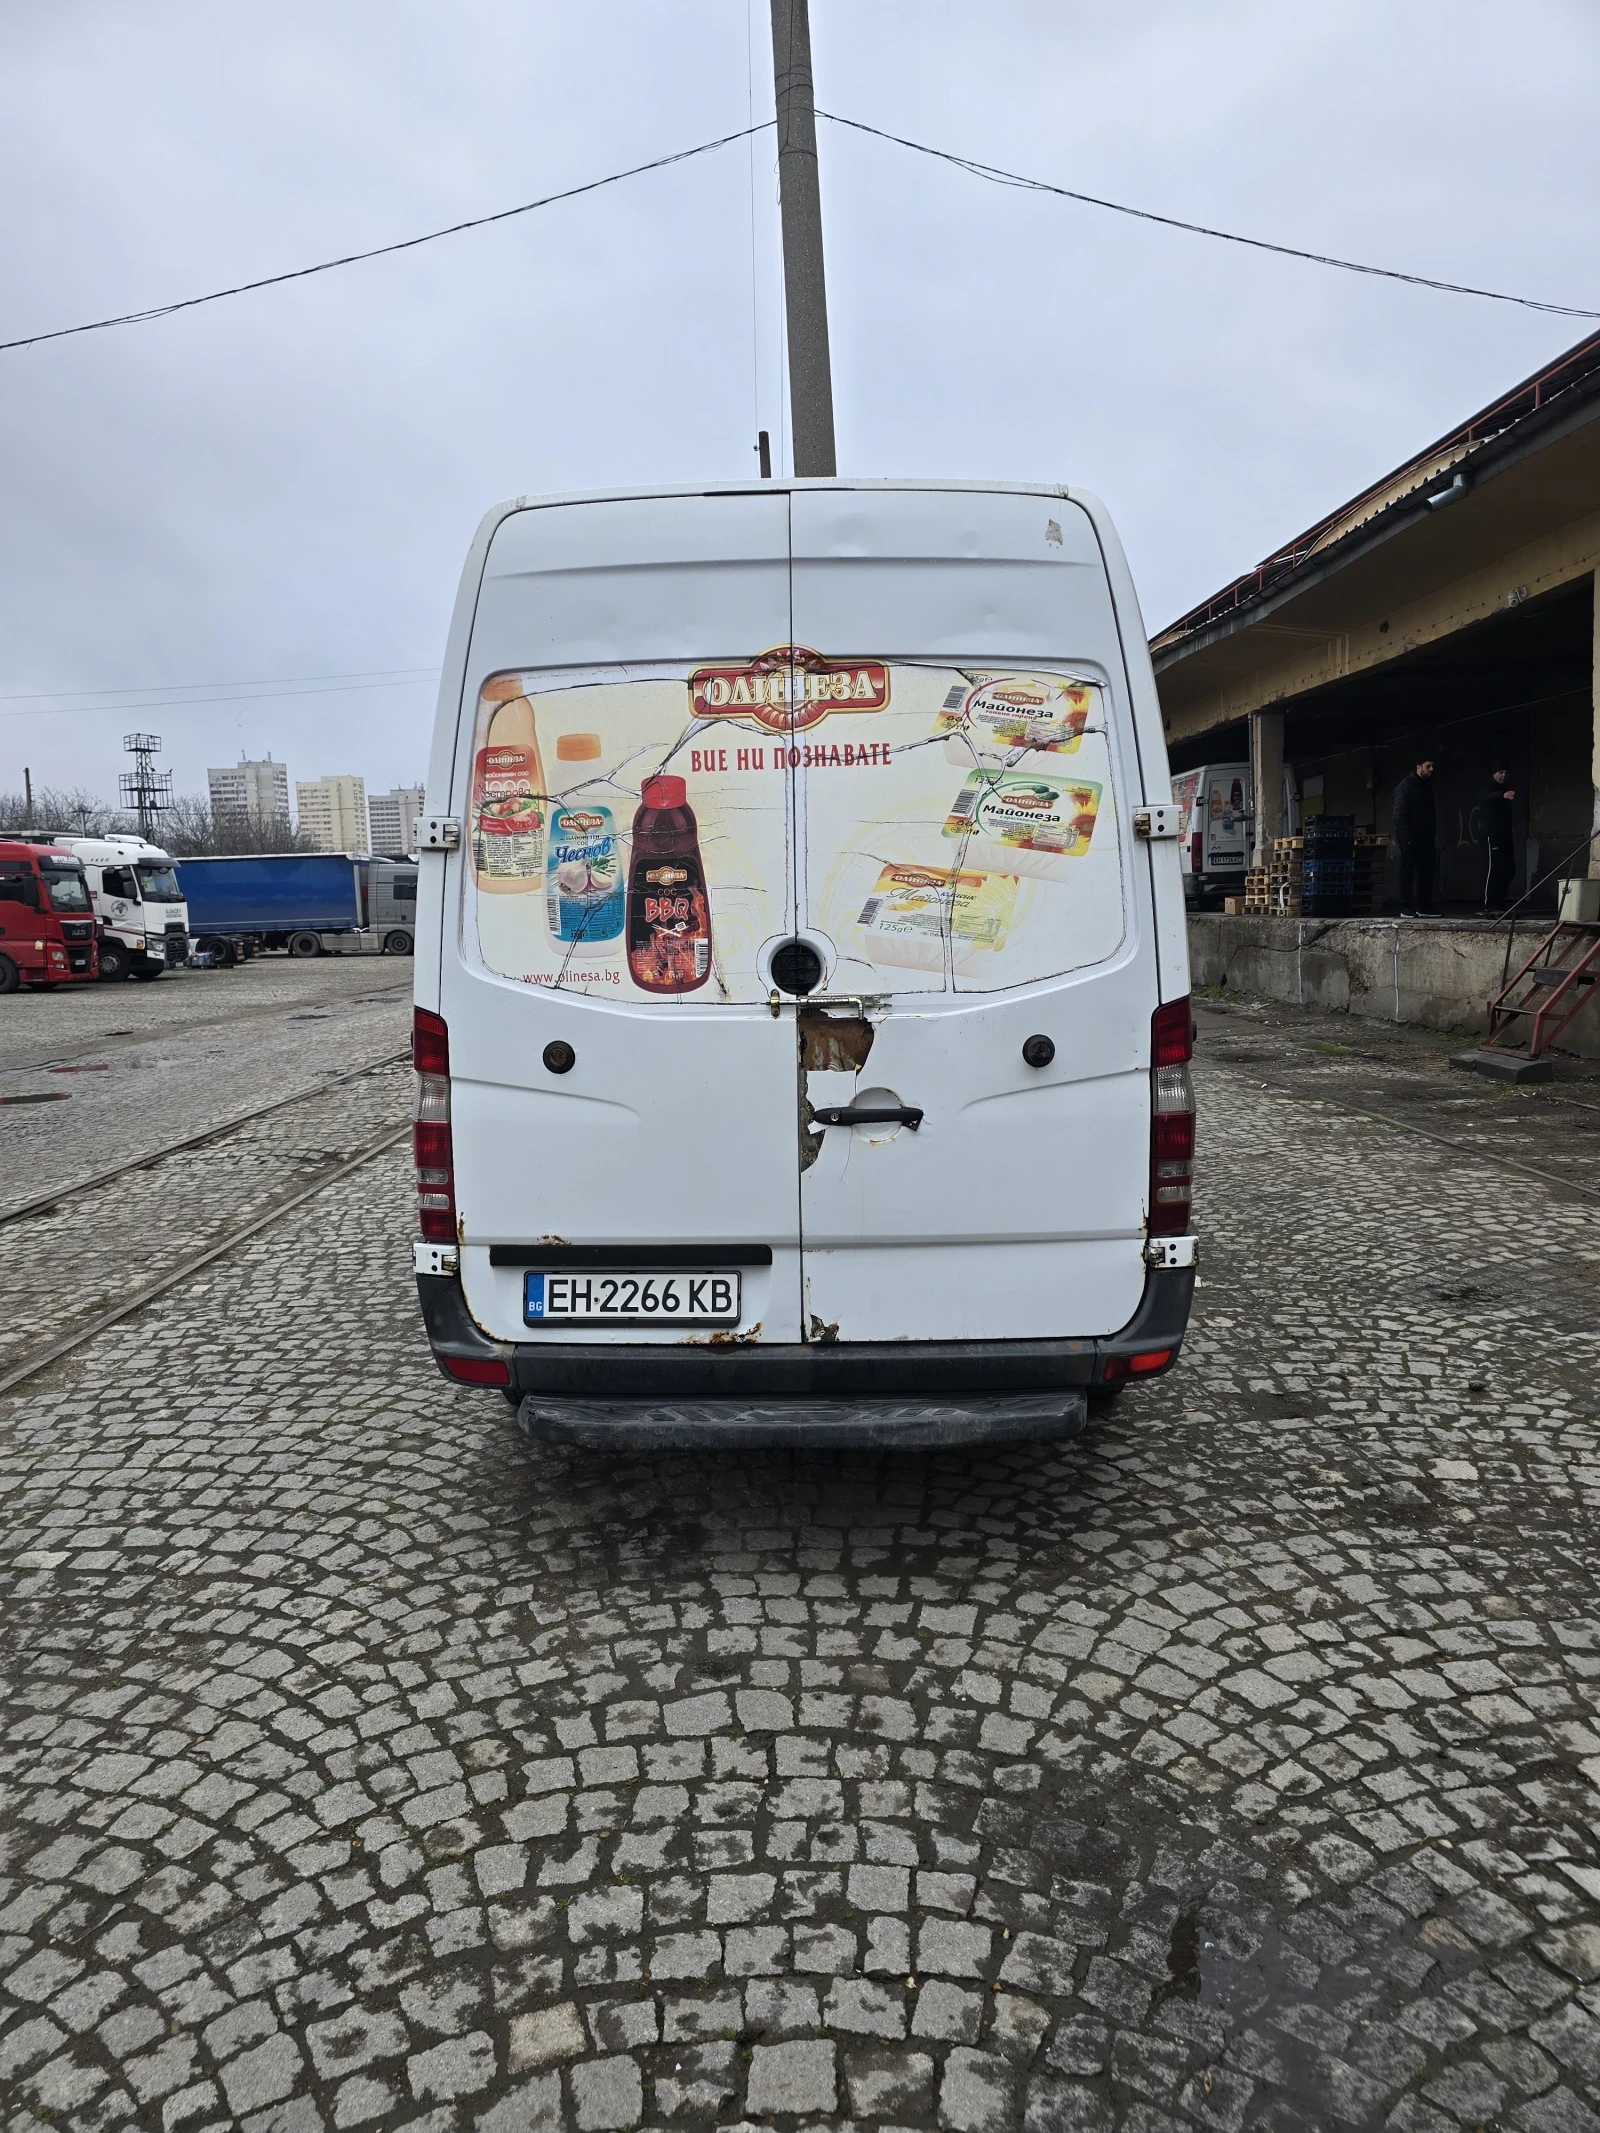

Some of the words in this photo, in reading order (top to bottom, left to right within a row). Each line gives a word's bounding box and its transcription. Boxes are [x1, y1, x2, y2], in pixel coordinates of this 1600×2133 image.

[701, 670, 877, 706] ОЛИНЕЗА
[973, 700, 1054, 718] Майонеза
[773, 742, 892, 770] ПОЗНАВАТЕ
[484, 779, 531, 792] 1000
[982, 804, 1061, 822] Майонеза
[555, 836, 612, 864] Чеснов
[645, 897, 690, 923] BBQ
[528, 1301, 543, 1312] BG
[548, 1279, 592, 1313] EH
[600, 1279, 680, 1313] 2266
[688, 1279, 733, 1313] KB
